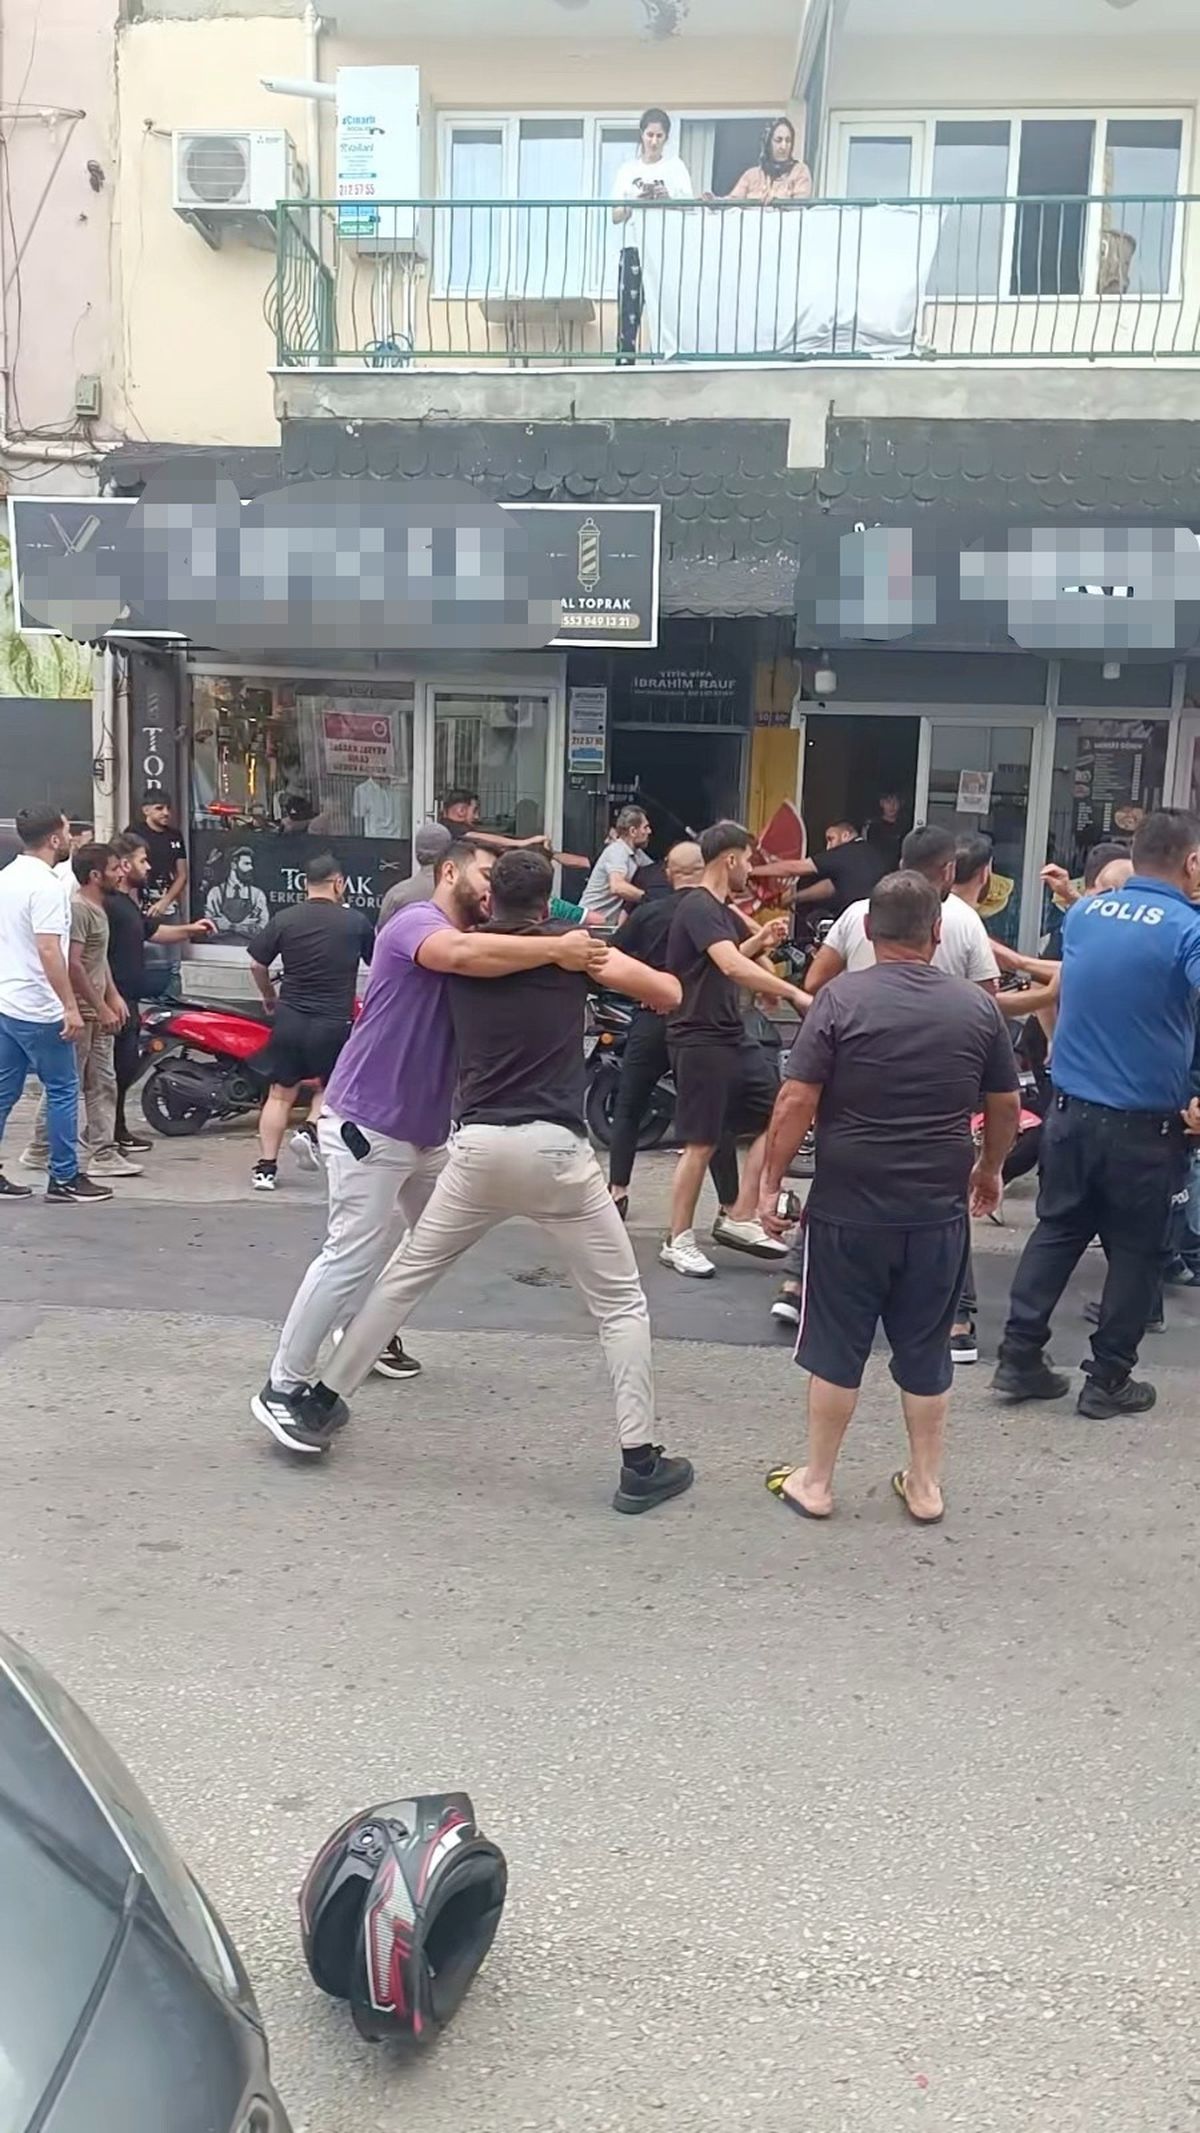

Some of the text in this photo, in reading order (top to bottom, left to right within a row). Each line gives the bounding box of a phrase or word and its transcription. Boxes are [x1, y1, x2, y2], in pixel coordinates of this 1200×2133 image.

[339, 184, 375, 196] 212 57 55
[579, 598, 632, 610] TOPRAK
[584, 616, 603, 626] 949
[618, 617, 630, 627] 21
[700, 680, 736, 690] RAUF
[281, 868, 373, 896] TOAK
[1084, 899, 1165, 925] POLİS
